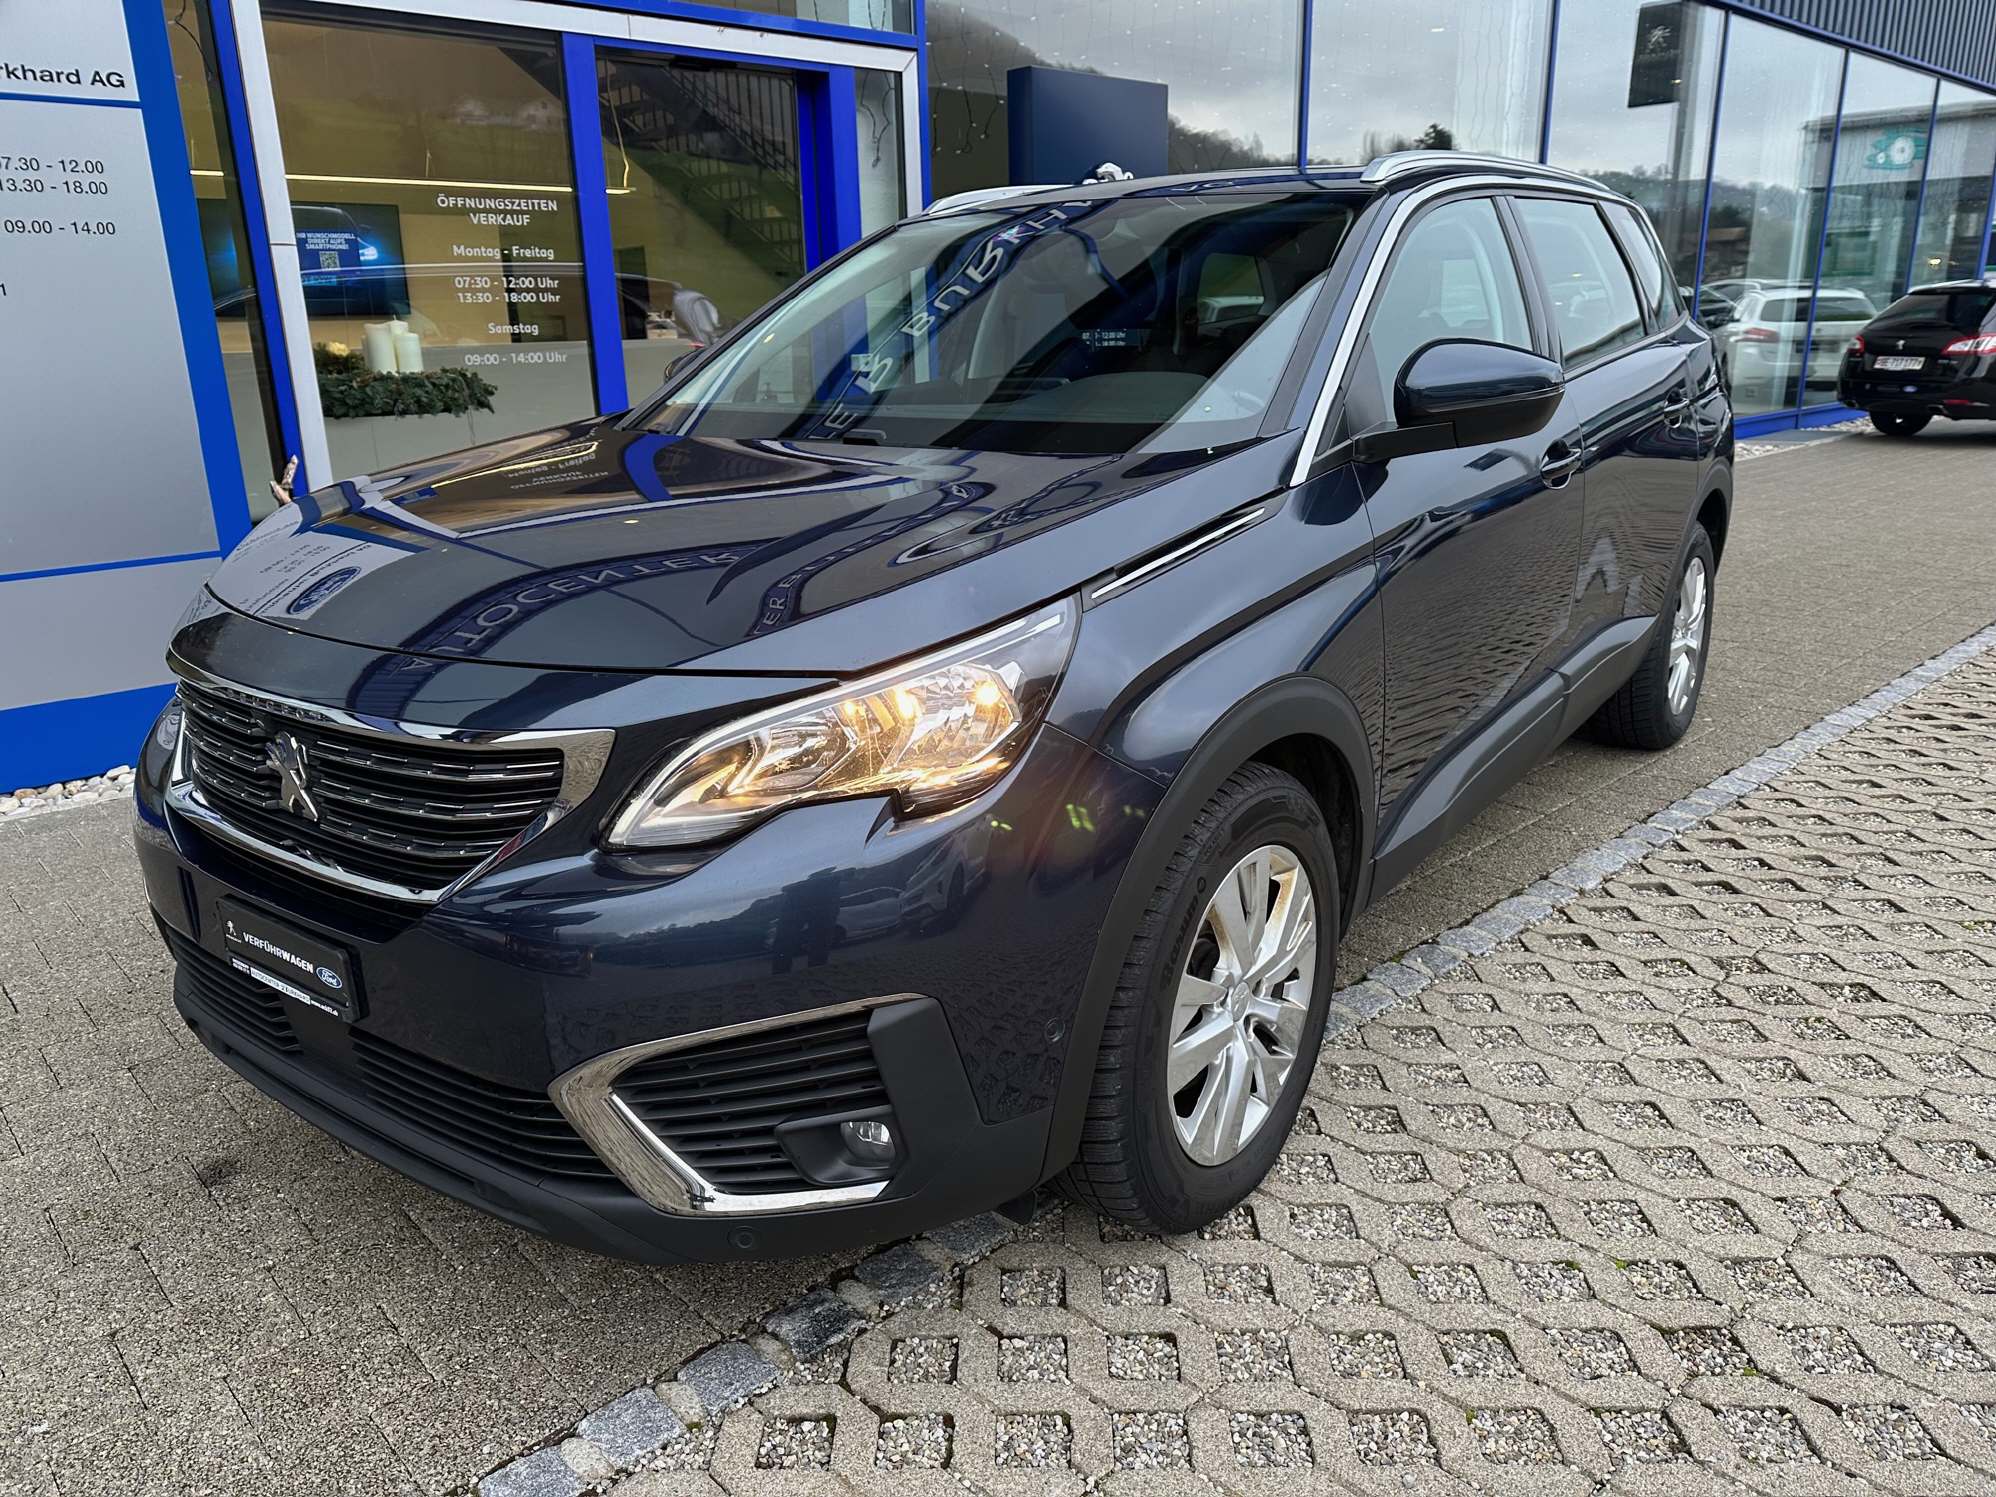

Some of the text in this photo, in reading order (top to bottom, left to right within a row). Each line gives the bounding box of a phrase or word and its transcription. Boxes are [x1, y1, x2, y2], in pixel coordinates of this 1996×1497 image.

[90, 70, 126, 89] AG
[0, 156, 40, 172] 7.30
[58, 159, 104, 174] 12.00
[62, 180, 108, 195] 18.00
[437, 193, 558, 211] ÖFFNUNGSZEITEN
[4, 219, 53, 234] 09.00
[70, 220, 116, 235] 14.00
[470, 213, 531, 226] VERKAUF
[452, 245, 501, 259] Montag
[511, 245, 555, 260] Freitag
[454, 277, 491, 289] 07:30
[502, 277, 535, 289] 12:00
[537, 276, 560, 289] Uhr
[458, 292, 493, 304] 13:30
[504, 292, 537, 303] 18:00
[539, 292, 562, 303] Uhr
[488, 322, 539, 336] Samstag
[464, 353, 500, 366] 09:00
[510, 352, 544, 365] 14:00
[546, 351, 568, 363] Uhr
[242, 932, 314, 974] VERFÜHRWAGEN
